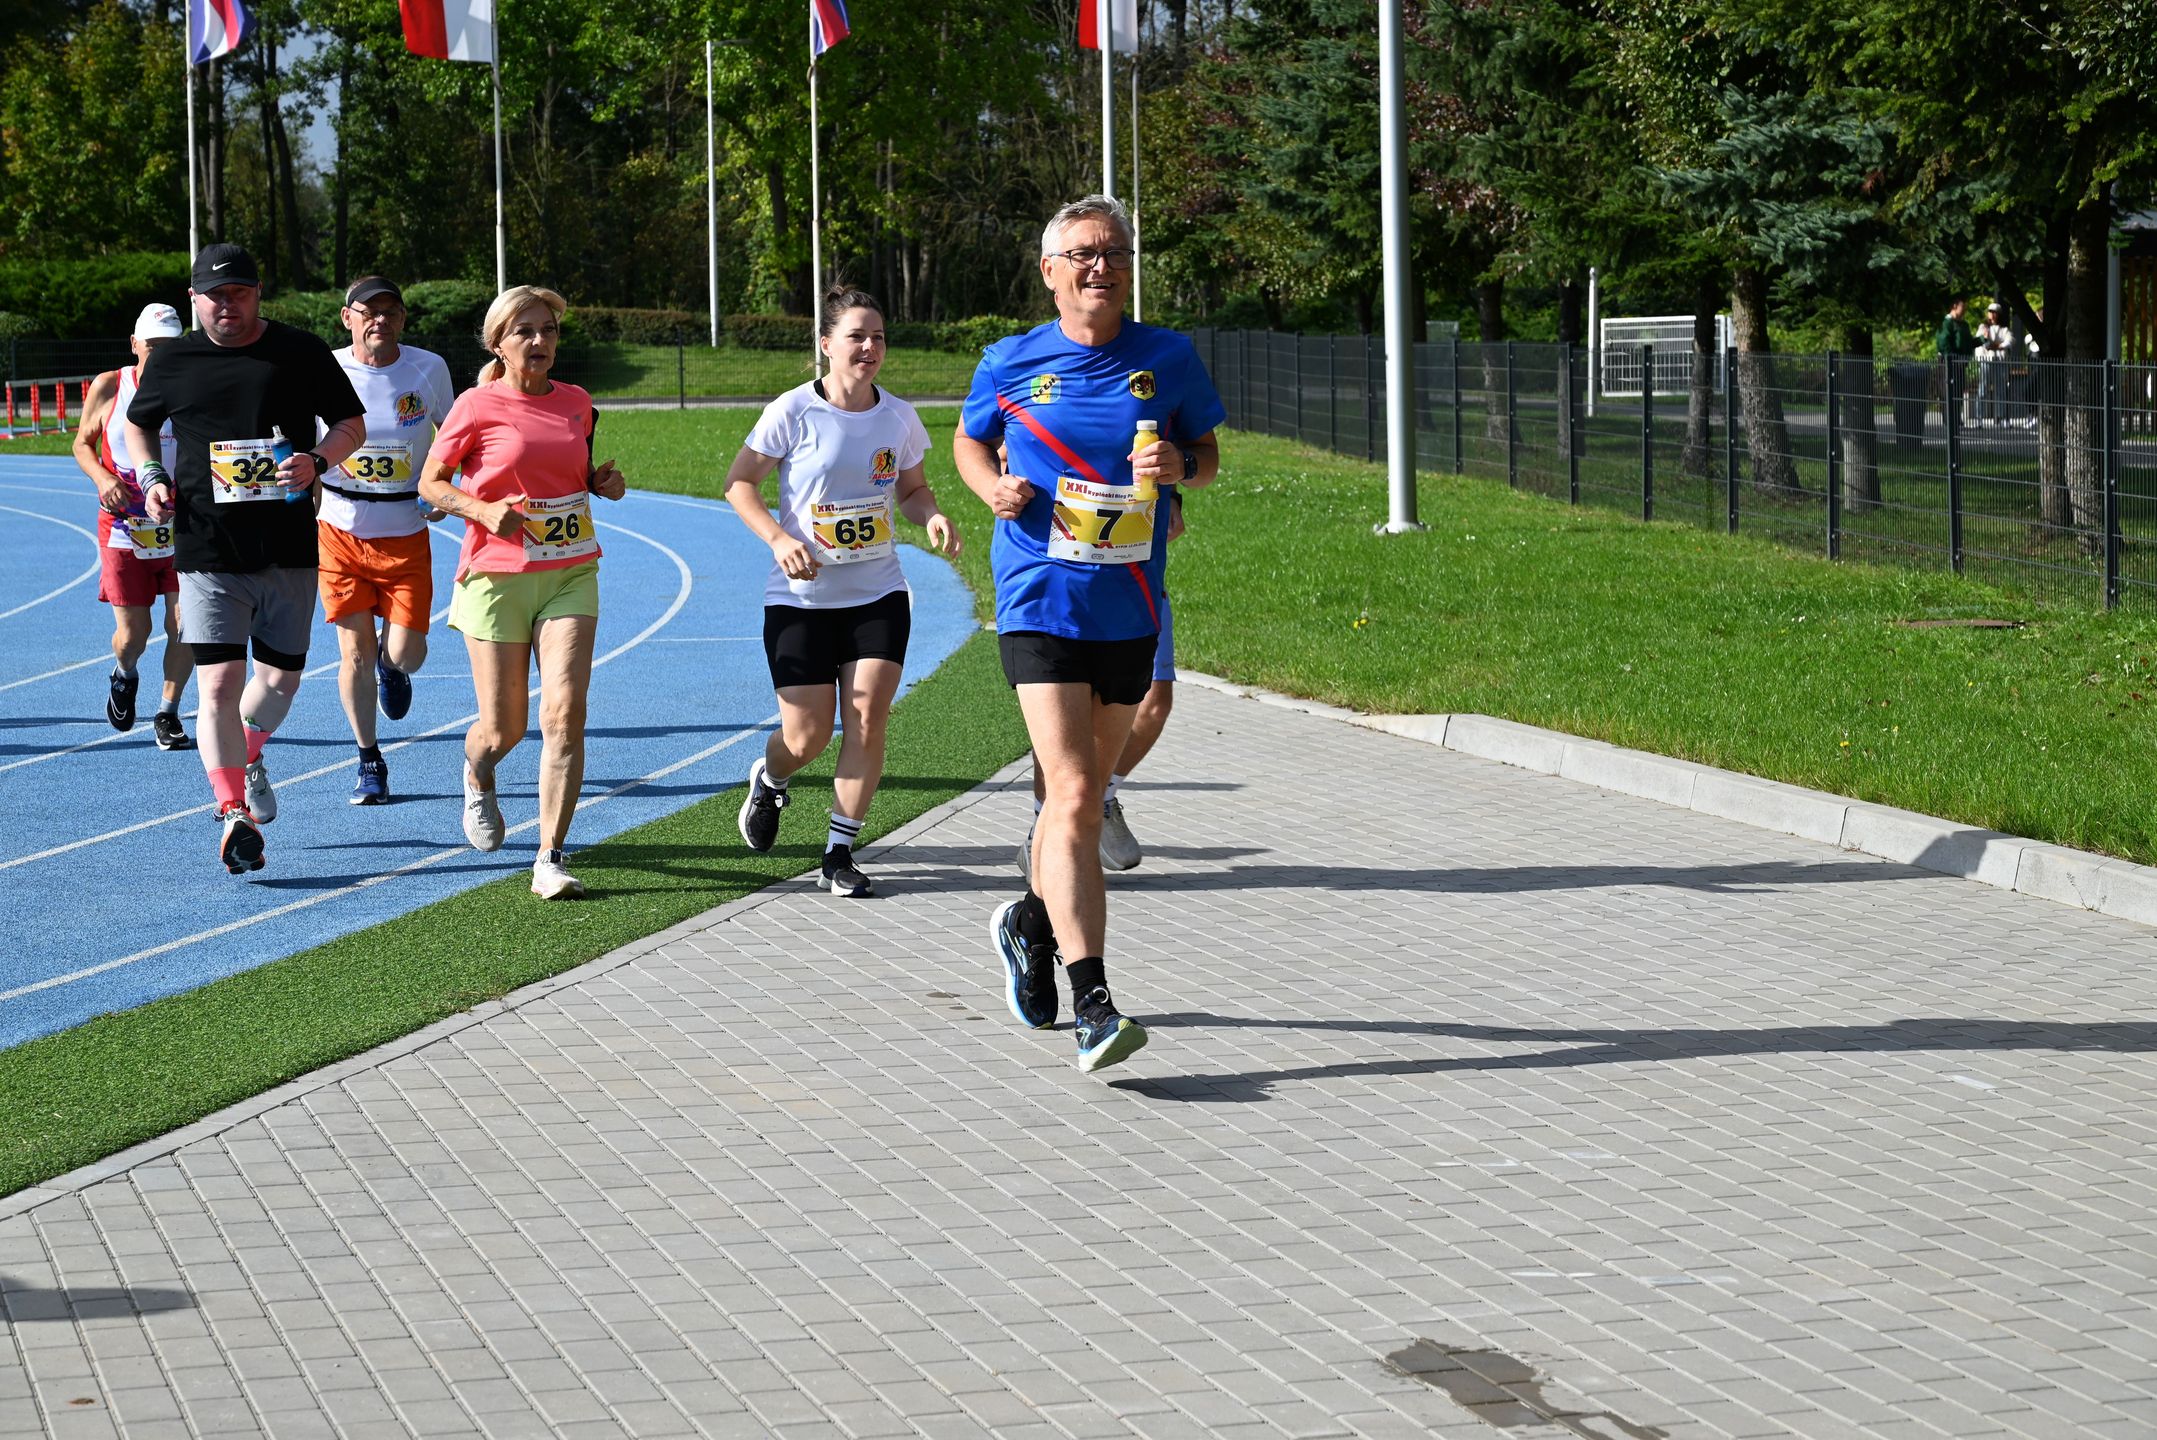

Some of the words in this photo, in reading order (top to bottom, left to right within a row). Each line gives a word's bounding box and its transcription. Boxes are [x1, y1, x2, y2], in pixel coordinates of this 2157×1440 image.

[232, 457, 276, 484] 32
[356, 455, 394, 478] 33
[1065, 481, 1088, 494] XXI
[817, 504, 834, 512] XXI
[155, 527, 170, 544] 8
[544, 513, 580, 542] 26
[835, 516, 875, 544] 65
[1096, 508, 1123, 541] 7
